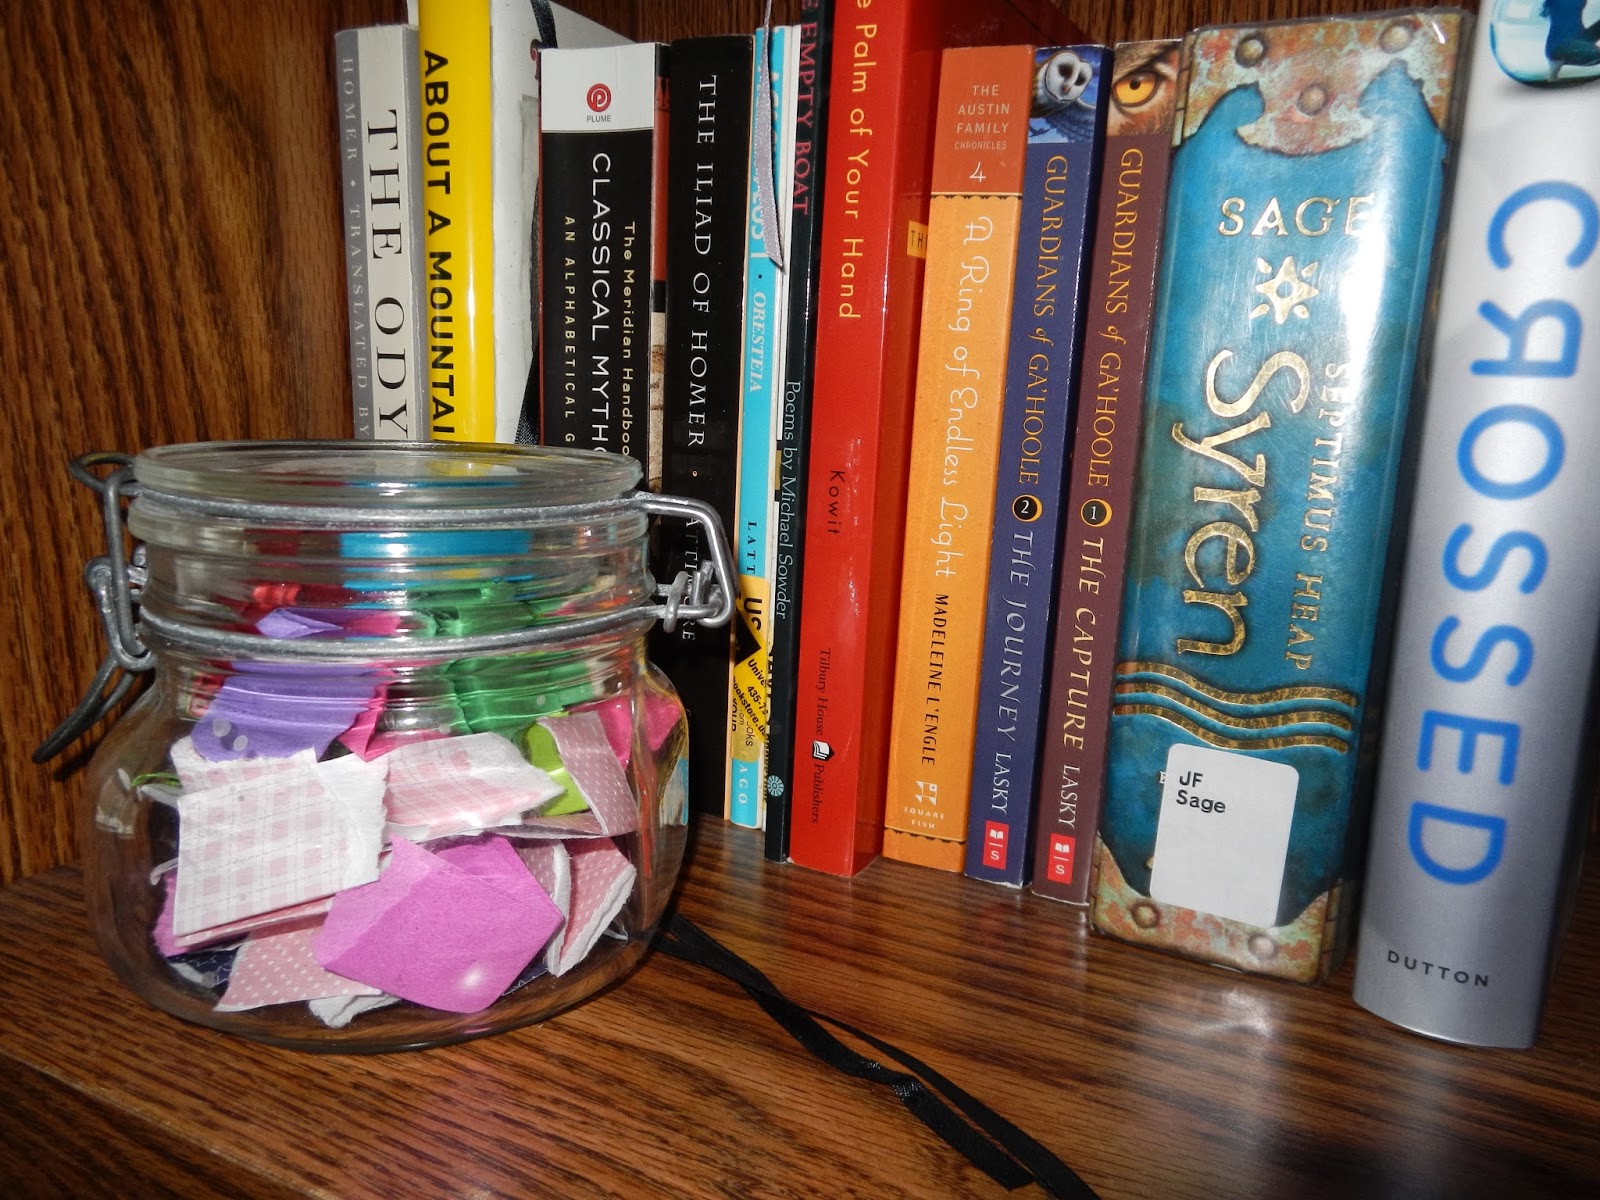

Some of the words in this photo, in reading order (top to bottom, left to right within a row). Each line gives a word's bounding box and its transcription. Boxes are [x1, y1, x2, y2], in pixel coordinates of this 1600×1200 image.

[797, 22, 817, 128] EMPTY
[852, 24, 877, 92] Palm
[971, 85, 1000, 96] THE
[342, 59, 357, 160] HOMER
[424, 50, 451, 194] ABOUT
[586, 114, 612, 122] PLUME
[697, 75, 717, 144] THE
[849, 108, 872, 136] of
[956, 121, 1010, 134] FAMILY
[957, 103, 1010, 116] AUSTIN
[954, 140, 1007, 150] CHRONICLES
[970, 162, 986, 183] 4
[367, 109, 403, 259] THE
[694, 163, 714, 255] ILIAD
[793, 141, 813, 215] BOAT
[844, 149, 869, 219] Your
[427, 210, 451, 236] A
[565, 216, 576, 241] AN
[592, 152, 611, 341] CLASSICAL
[624, 222, 636, 260] The
[963, 217, 993, 245] A
[1033, 156, 1068, 317] GUARDIANS
[1105, 148, 1143, 314] GUARDIANS
[1219, 195, 1376, 237] SAGE
[349, 205, 367, 388] TRANSLATED
[692, 272, 711, 312] OF
[839, 238, 864, 319] Hand
[948, 256, 989, 332] Ring
[565, 257, 576, 418] ALPHABETICAL
[622, 269, 635, 359] Meridian
[750, 292, 766, 393] ORESTEIA
[1027, 328, 1053, 347] of
[1100, 326, 1126, 346] of
[428, 252, 455, 442] MOUNTAI
[946, 346, 980, 380] of
[591, 355, 610, 452] MYTH
[687, 330, 707, 447] HOMER
[785, 380, 801, 440] Poems
[1018, 353, 1050, 486] GA'HOOLE
[1087, 351, 1122, 487] GA'HOOLE
[358, 407, 369, 436] BY
[941, 387, 978, 486] Endless
[783, 445, 798, 470] by
[1300, 361, 1352, 553] SEPTIMUS
[778, 477, 796, 547] Michael
[828, 470, 846, 535] Kowit
[1019, 500, 1030, 514] 2
[1090, 506, 1097, 520] 1
[1171, 348, 1311, 656] Syren
[1408, 180, 1600, 886] CROSSED
[930, 497, 968, 578] Light
[1009, 531, 1034, 587] THE
[1078, 537, 1104, 595] THE
[776, 555, 793, 620] Sowder
[926, 594, 948, 691] MADELEINE
[1284, 572, 1324, 671] HEAP
[817, 648, 832, 695] Tilbury
[997, 597, 1026, 747] JOURNEY
[1064, 606, 1096, 751] CAPTURE
[815, 696, 828, 736] House
[921, 697, 941, 765] L'ENGLE
[812, 763, 825, 824] Publishers
[992, 752, 1012, 815] LASKY
[1057, 765, 1080, 828] LASKY
[1176, 789, 1226, 813] Sage
[1179, 771, 1203, 787] JF
[904, 806, 945, 820] SQUARE
[911, 818, 936, 830] FISH
[1387, 950, 1490, 987] DUTTON
